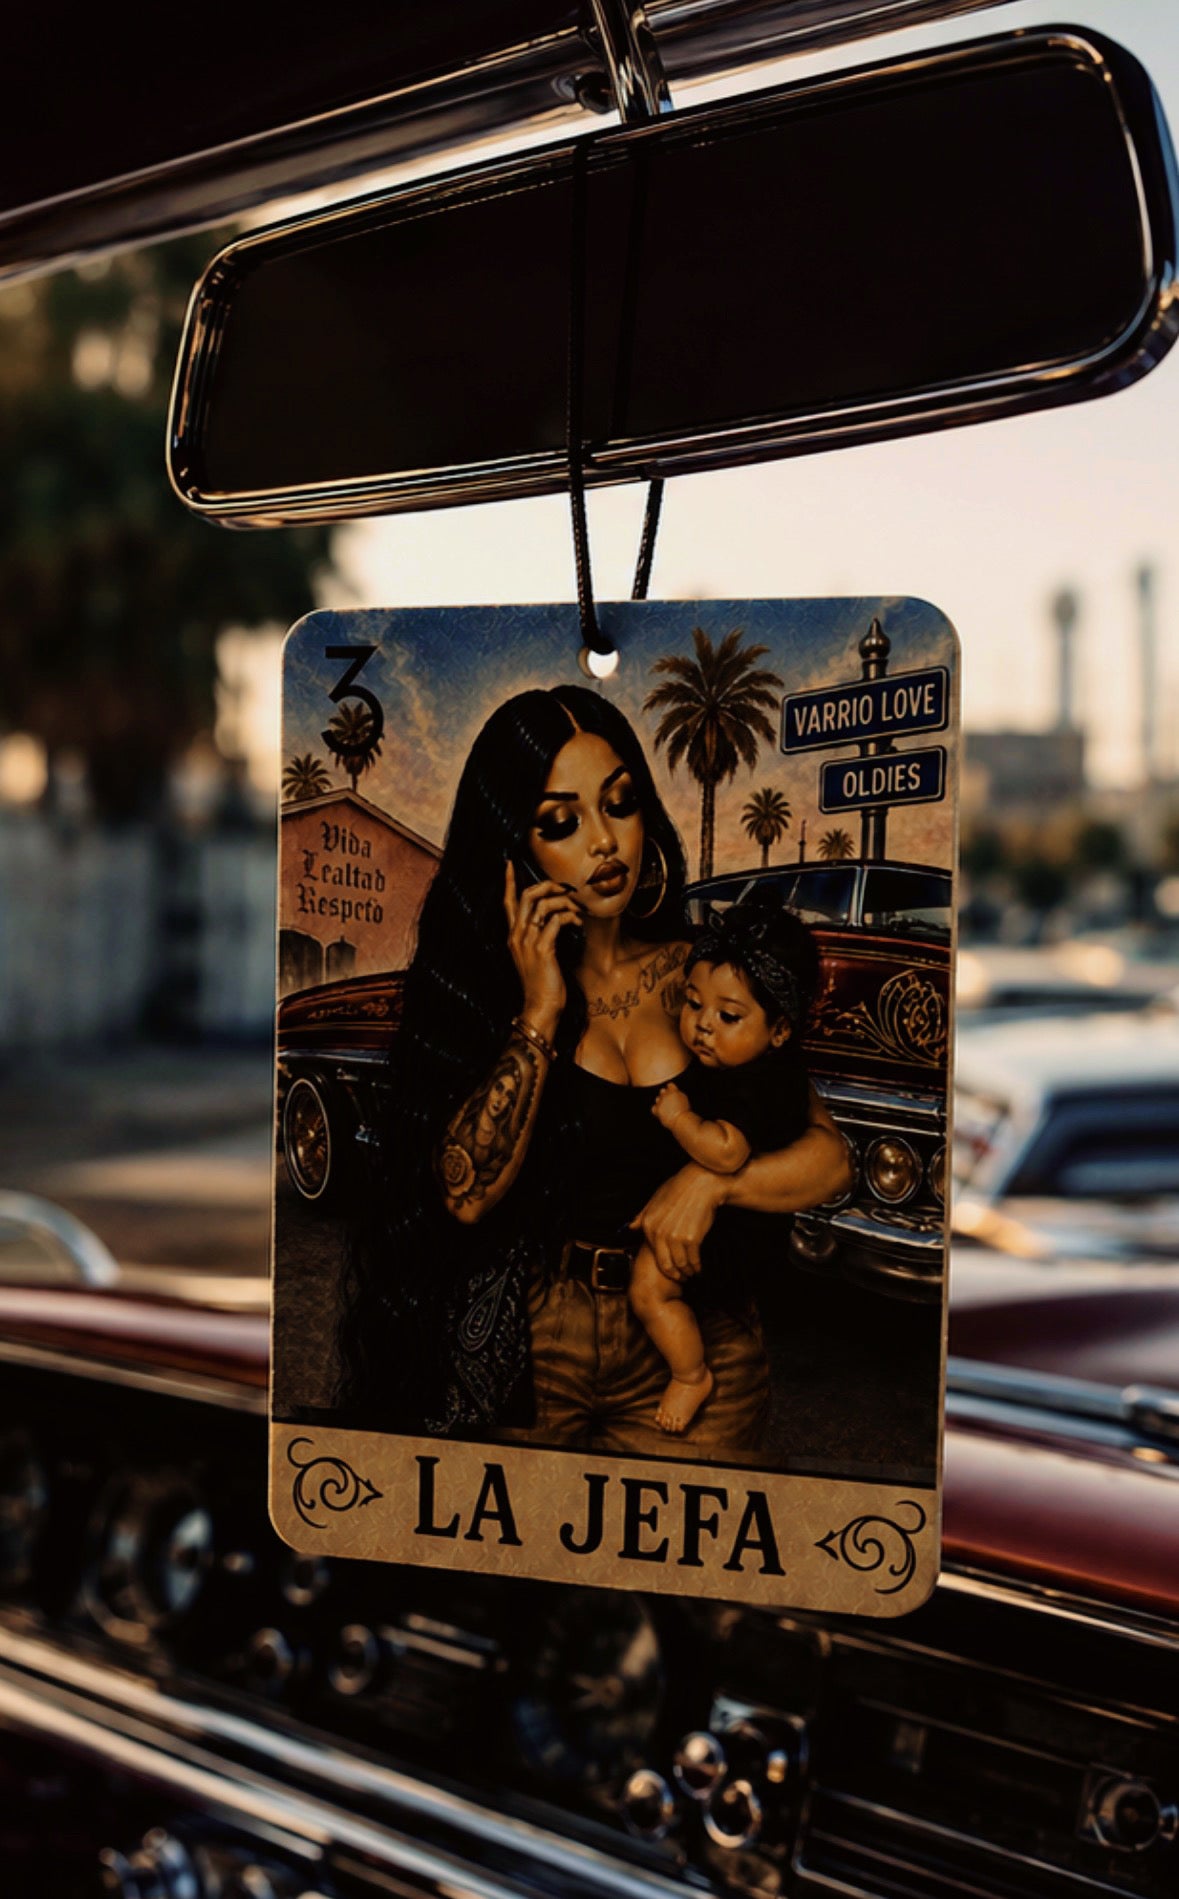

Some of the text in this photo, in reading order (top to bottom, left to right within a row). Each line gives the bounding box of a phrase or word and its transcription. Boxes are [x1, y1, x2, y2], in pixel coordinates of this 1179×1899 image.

[321, 645, 384, 755] 3
[794, 683, 935, 737] VARRIO LOVE
[842, 764, 921, 798] OLDIES
[321, 822, 371, 858] Vida
[302, 849, 386, 892] Lealtad
[297, 884, 383, 924] Respeto
[414, 1455, 787, 1577] LA JEFA
